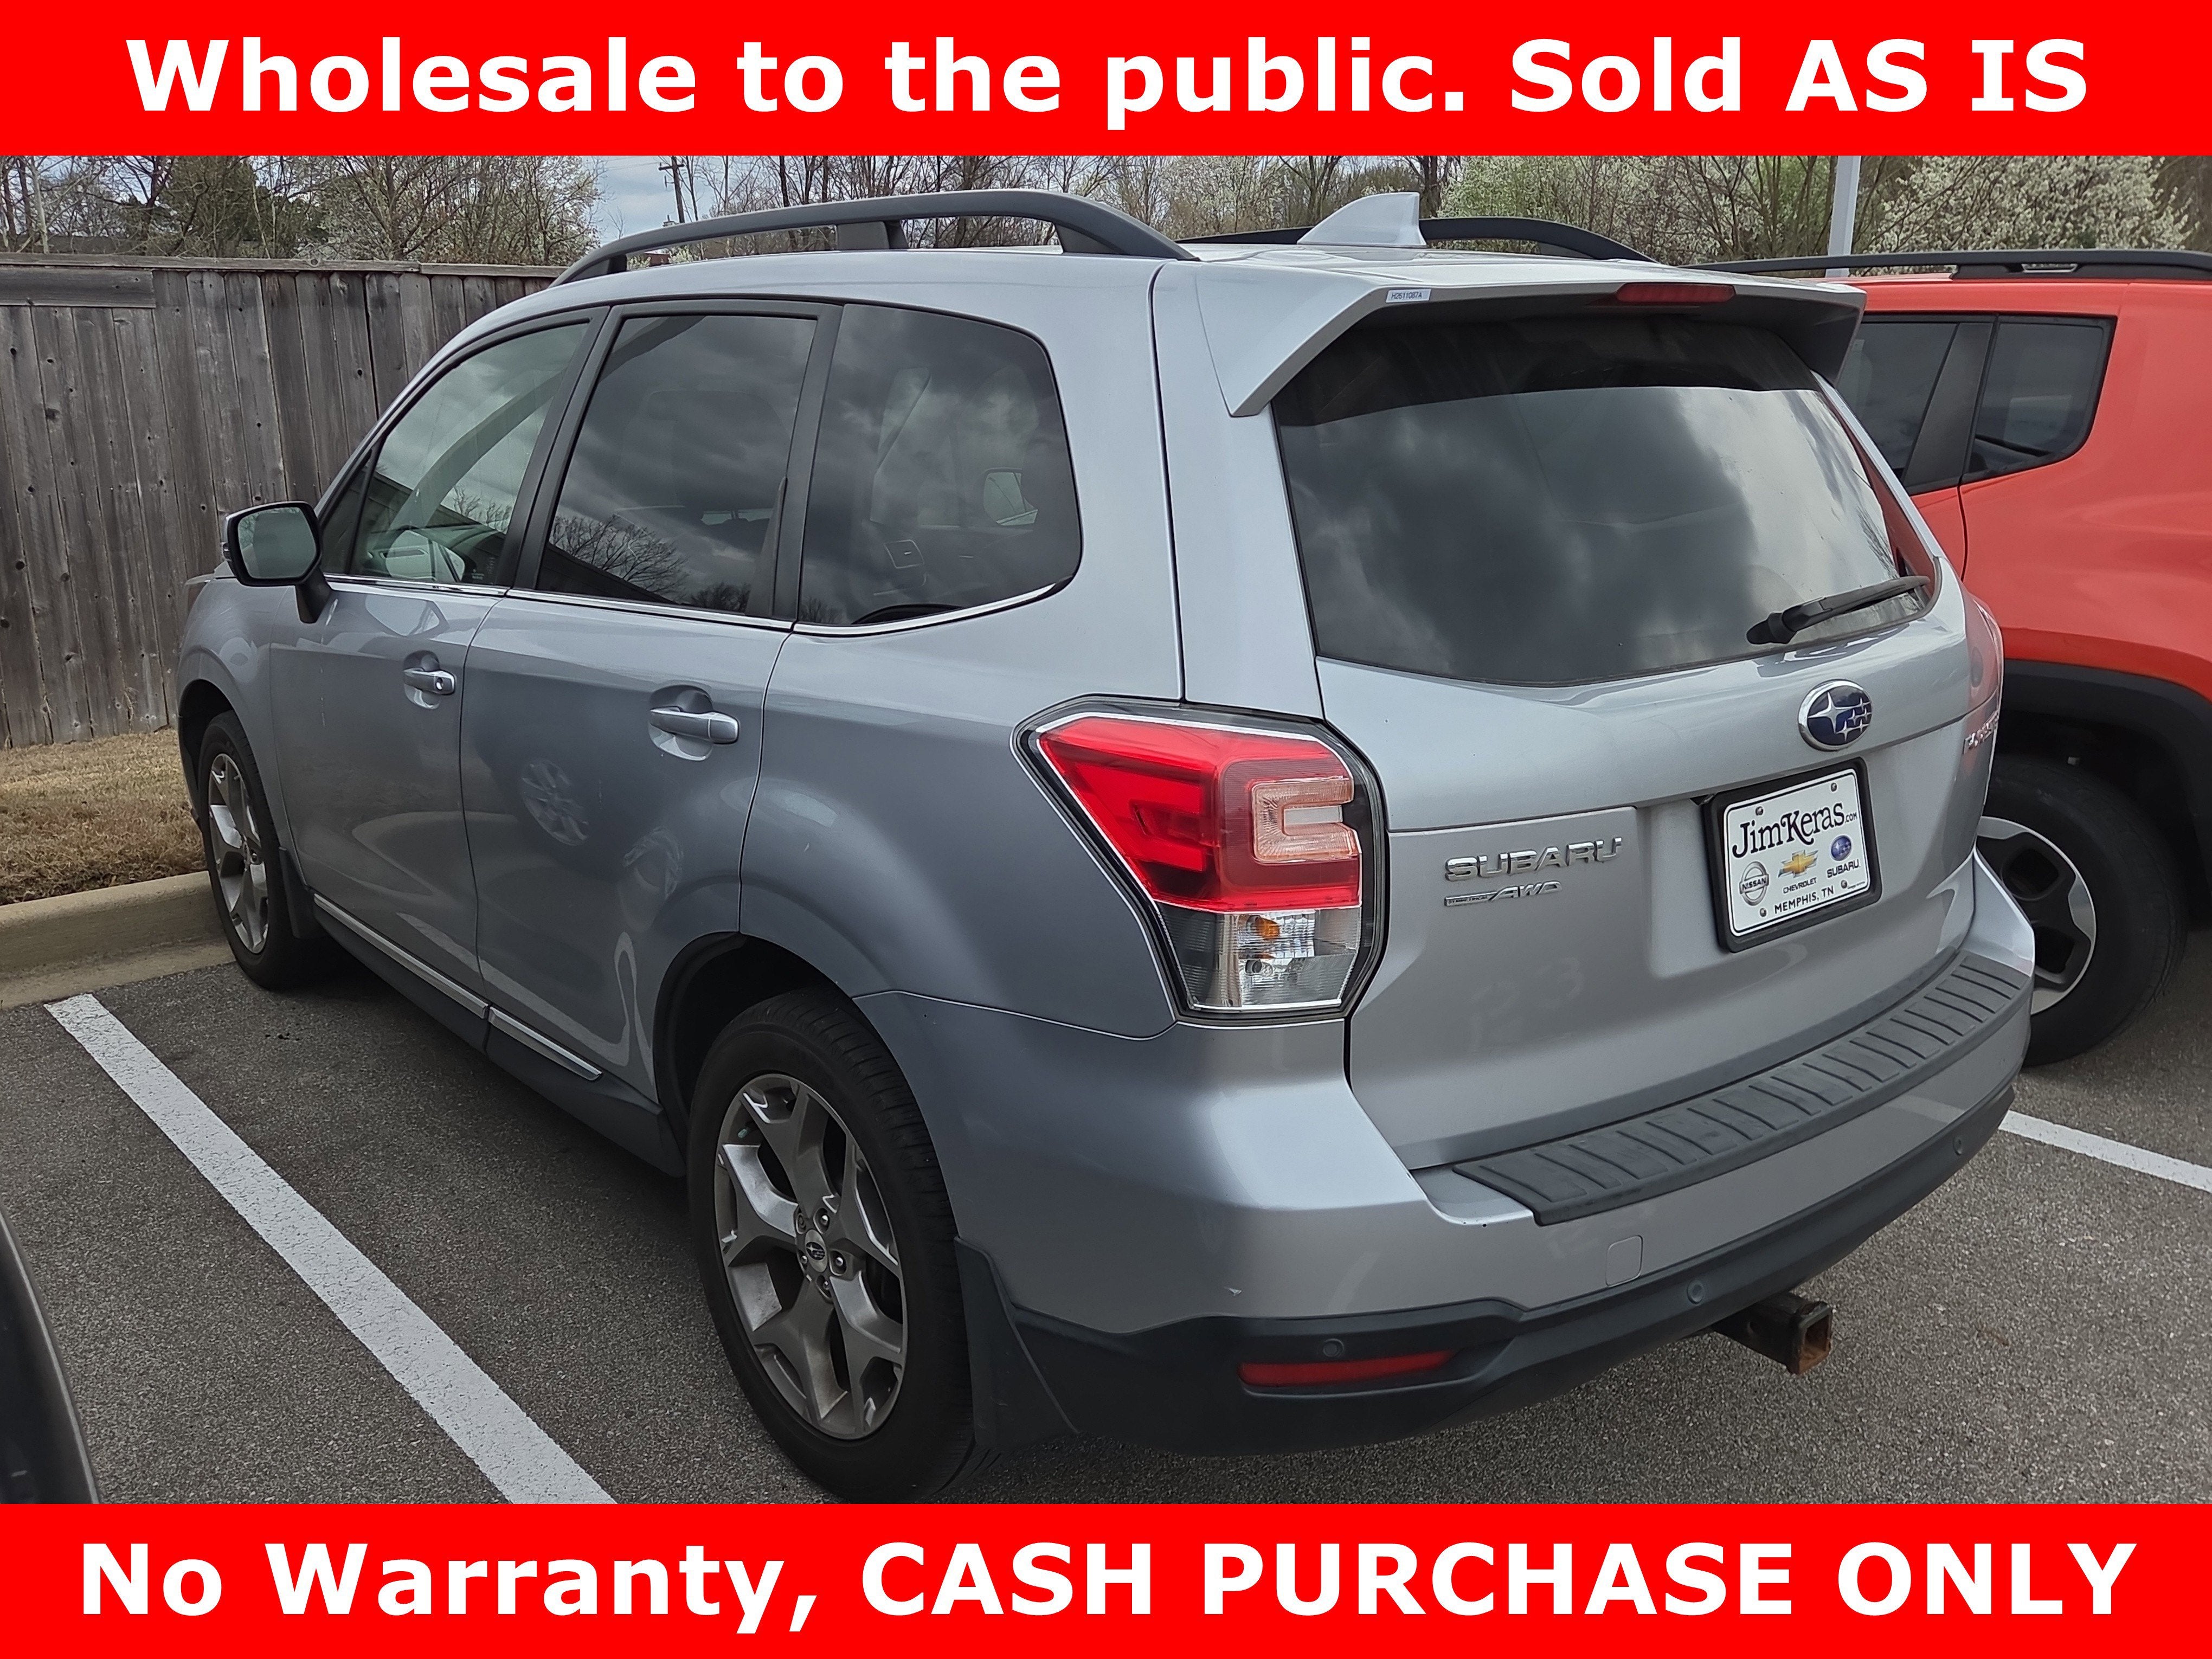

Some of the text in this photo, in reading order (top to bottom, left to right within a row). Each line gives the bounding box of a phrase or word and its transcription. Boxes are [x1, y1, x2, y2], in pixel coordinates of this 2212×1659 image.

[1445, 837, 1623, 882] SUBARU
[1827, 859, 1859, 878] SUBARU
[1490, 880, 1562, 901] AWD
[1742, 877, 1766, 891] NISSAN
[1783, 877, 1817, 894] CHEVROLET
[1774, 892, 1819, 914] MEMPHIS,
[1821, 885, 1834, 898] TN
